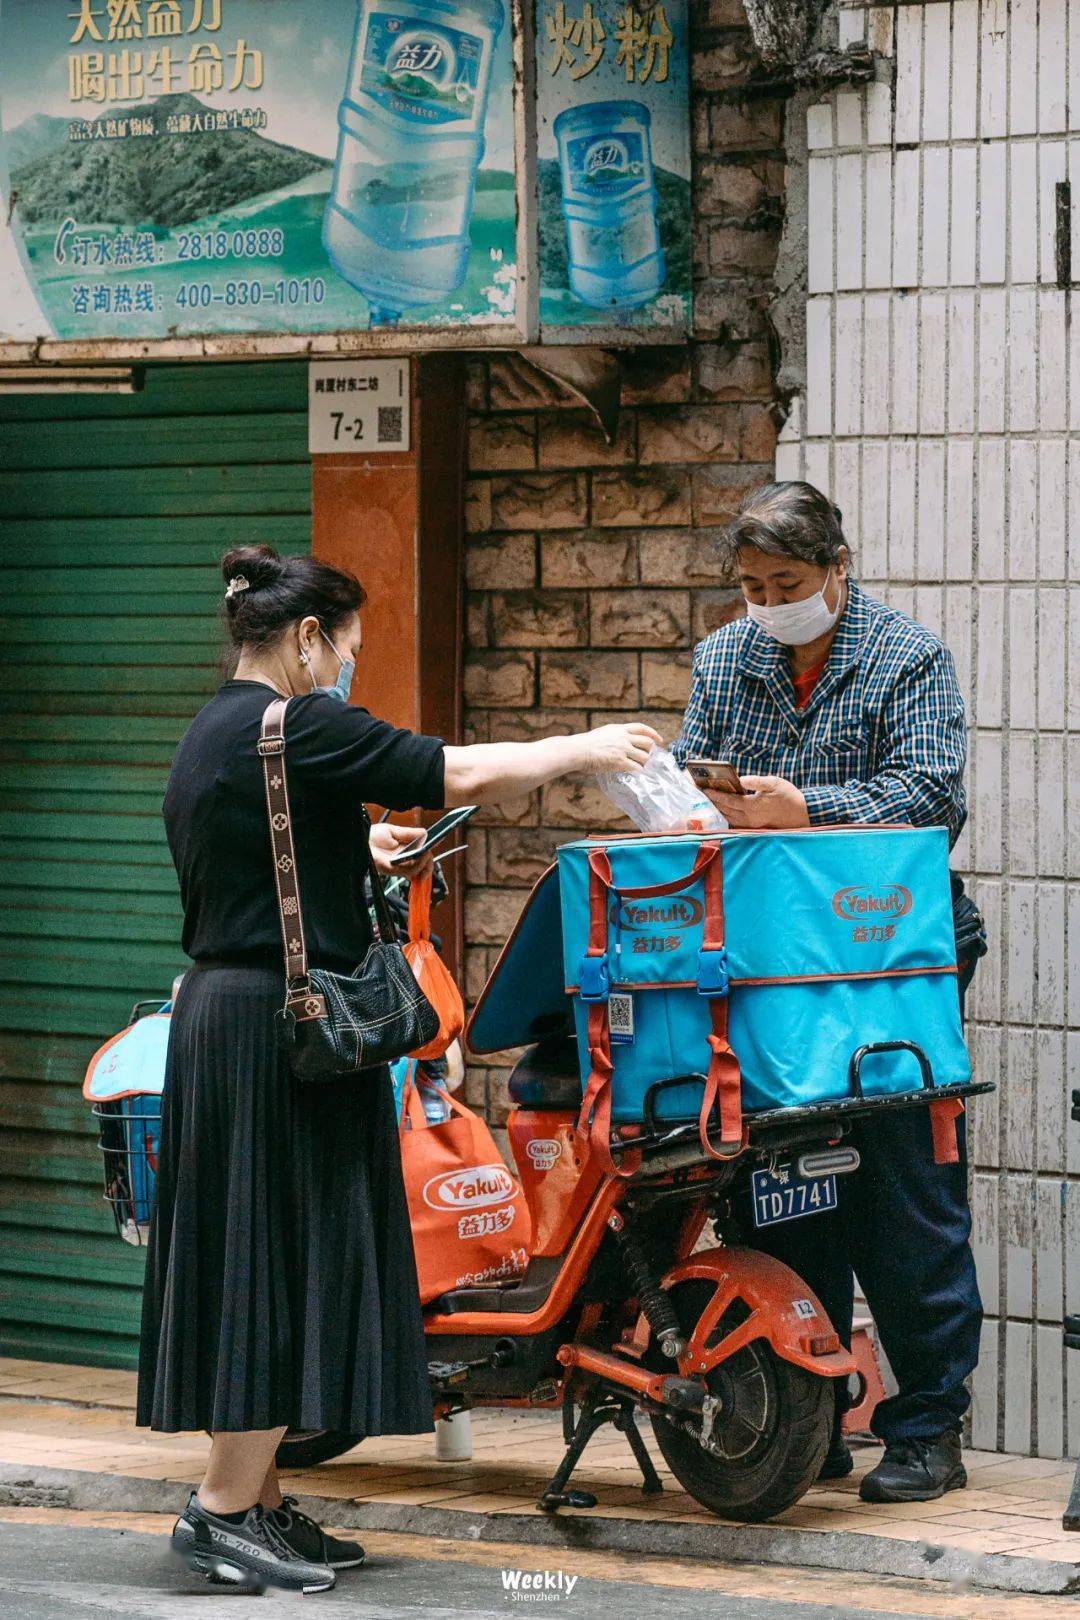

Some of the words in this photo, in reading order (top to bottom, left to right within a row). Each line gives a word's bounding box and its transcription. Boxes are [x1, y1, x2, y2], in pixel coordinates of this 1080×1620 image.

[67, 0, 222, 43] 天然益力
[546, 1, 673, 84] 炒粉
[68, 39, 263, 102] 喝出生命力
[391, 44, 442, 71] 益力
[176, 279, 325, 308] 400-830-1010
[330, 411, 363, 440] 7-2
[624, 903, 691, 924] Yakult
[845, 893, 904, 913] Yakult
[632, 935, 682, 954] 益力多
[852, 924, 896, 943] 益力多
[446, 1174, 511, 1200] Yakult
[758, 1179, 831, 1220] TD7741
[460, 1208, 513, 1237] 益力多
